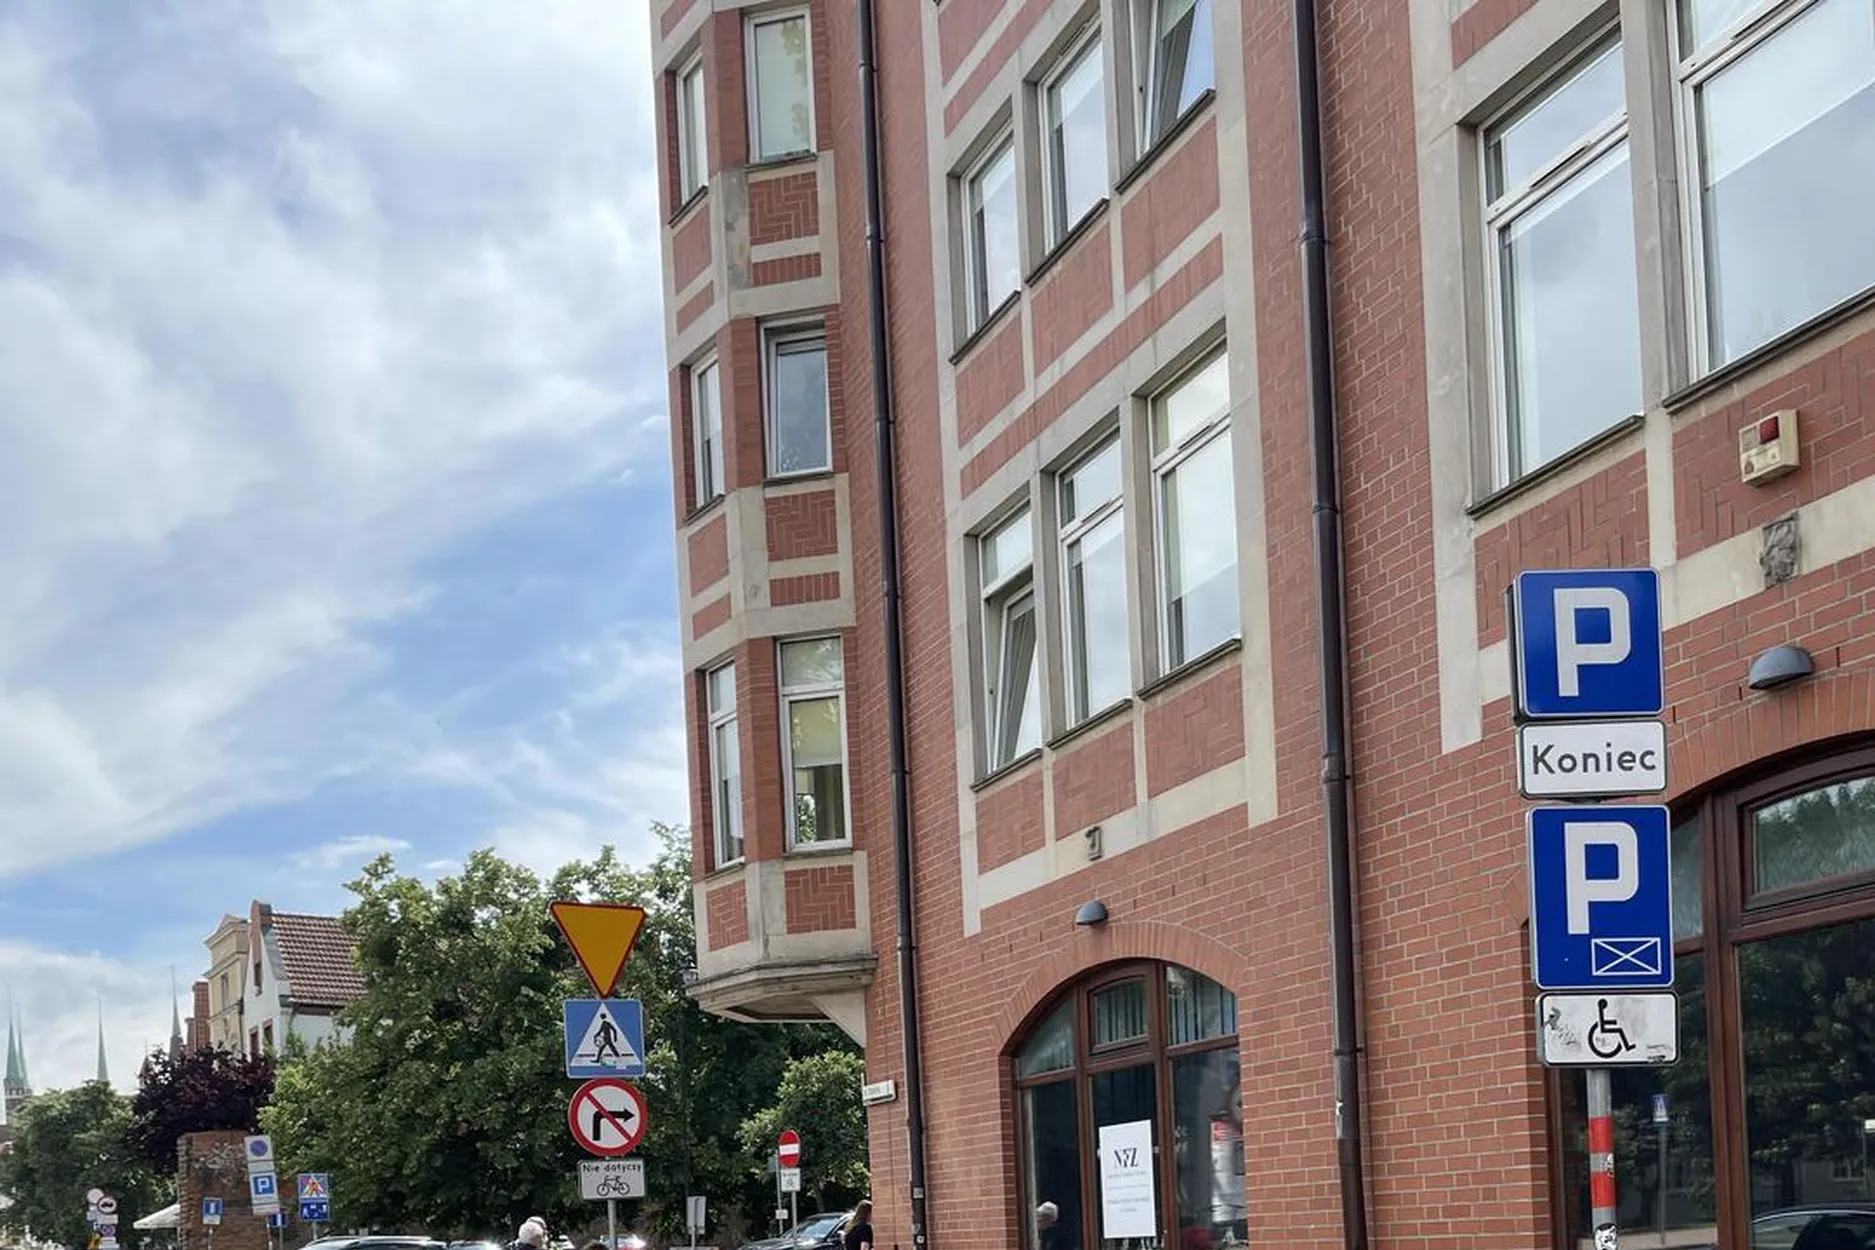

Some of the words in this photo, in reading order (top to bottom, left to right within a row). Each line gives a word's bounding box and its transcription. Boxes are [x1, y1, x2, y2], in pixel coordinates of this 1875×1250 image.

[1553, 587, 1632, 697] P
[1532, 742, 1657, 775] Koniec
[1564, 822, 1639, 934] P
[582, 1164, 600, 1173] Nie
[603, 1162, 641, 1173] dotyczy
[257, 1178, 271, 1193] P
